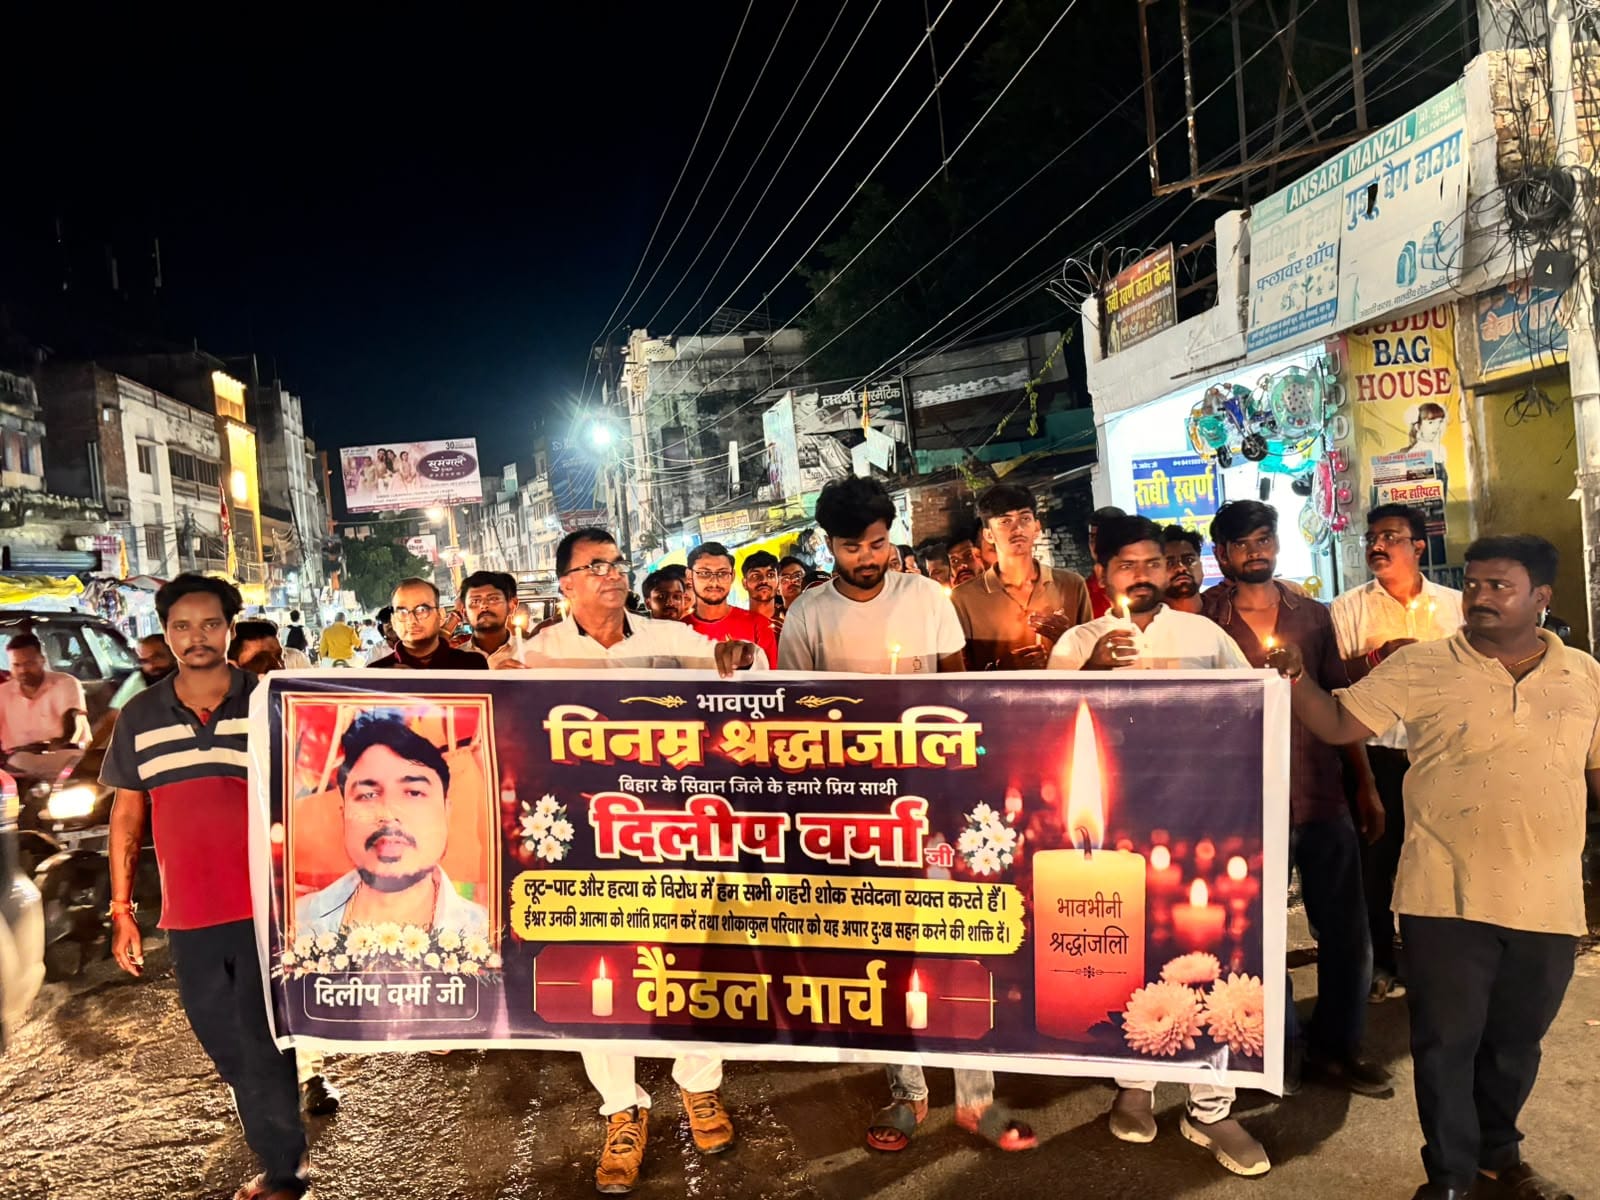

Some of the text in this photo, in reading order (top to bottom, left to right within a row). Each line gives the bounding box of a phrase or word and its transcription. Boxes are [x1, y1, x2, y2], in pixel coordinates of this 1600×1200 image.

[1288, 159, 1344, 210] ANSARI
[1349, 120, 1412, 176] MANZIL
[1383, 160, 1412, 198] बैग
[1414, 129, 1463, 184] हाउस
[1305, 242, 1336, 270] शॉप
[1372, 335, 1431, 367] BAG
[1355, 367, 1452, 402] HOUSE
[1171, 465, 1215, 507] स्वर्ण
[696, 688, 786, 719] भावपूर्ण
[543, 704, 984, 770] विनम्र श्रद्धांजलि
[618, 775, 899, 797] बिहार के सिवान जिले के हमारे प्रिय साथी
[588, 793, 954, 868] दिलीप वर्मा जी
[524, 872, 1008, 912] लूट-पाट और हत्या के विरोध में हम सभी गहरी शोक संवेदना व्यक्त करते हैं।
[1057, 891, 1124, 919] भावभीनी
[524, 905, 547, 930] ईश्वर
[548, 905, 577, 928] उनकी
[579, 910, 608, 929] आत्मा
[609, 905, 625, 928] को
[626, 907, 652, 929] शांति
[652, 914, 679, 930] प्रदान
[680, 909, 698, 931] करें
[698, 914, 720, 931] तथा
[721, 910, 769, 939] शोकाकुल
[770, 912, 805, 935] परिवार
[806, 914, 822, 937] को
[823, 918, 840, 938] यह
[841, 919, 869, 938] अपार
[871, 921, 893, 945] दुःख
[895, 921, 921, 940] सहन
[922, 918, 948, 942] करने
[950, 918, 966, 943] की
[967, 918, 995, 944] शक्ति
[1049, 925, 1130, 957] श्रद्धांजलि
[314, 976, 467, 1008] दिलीप वर्मा जी
[633, 946, 887, 1027] कैंडल मार्च
